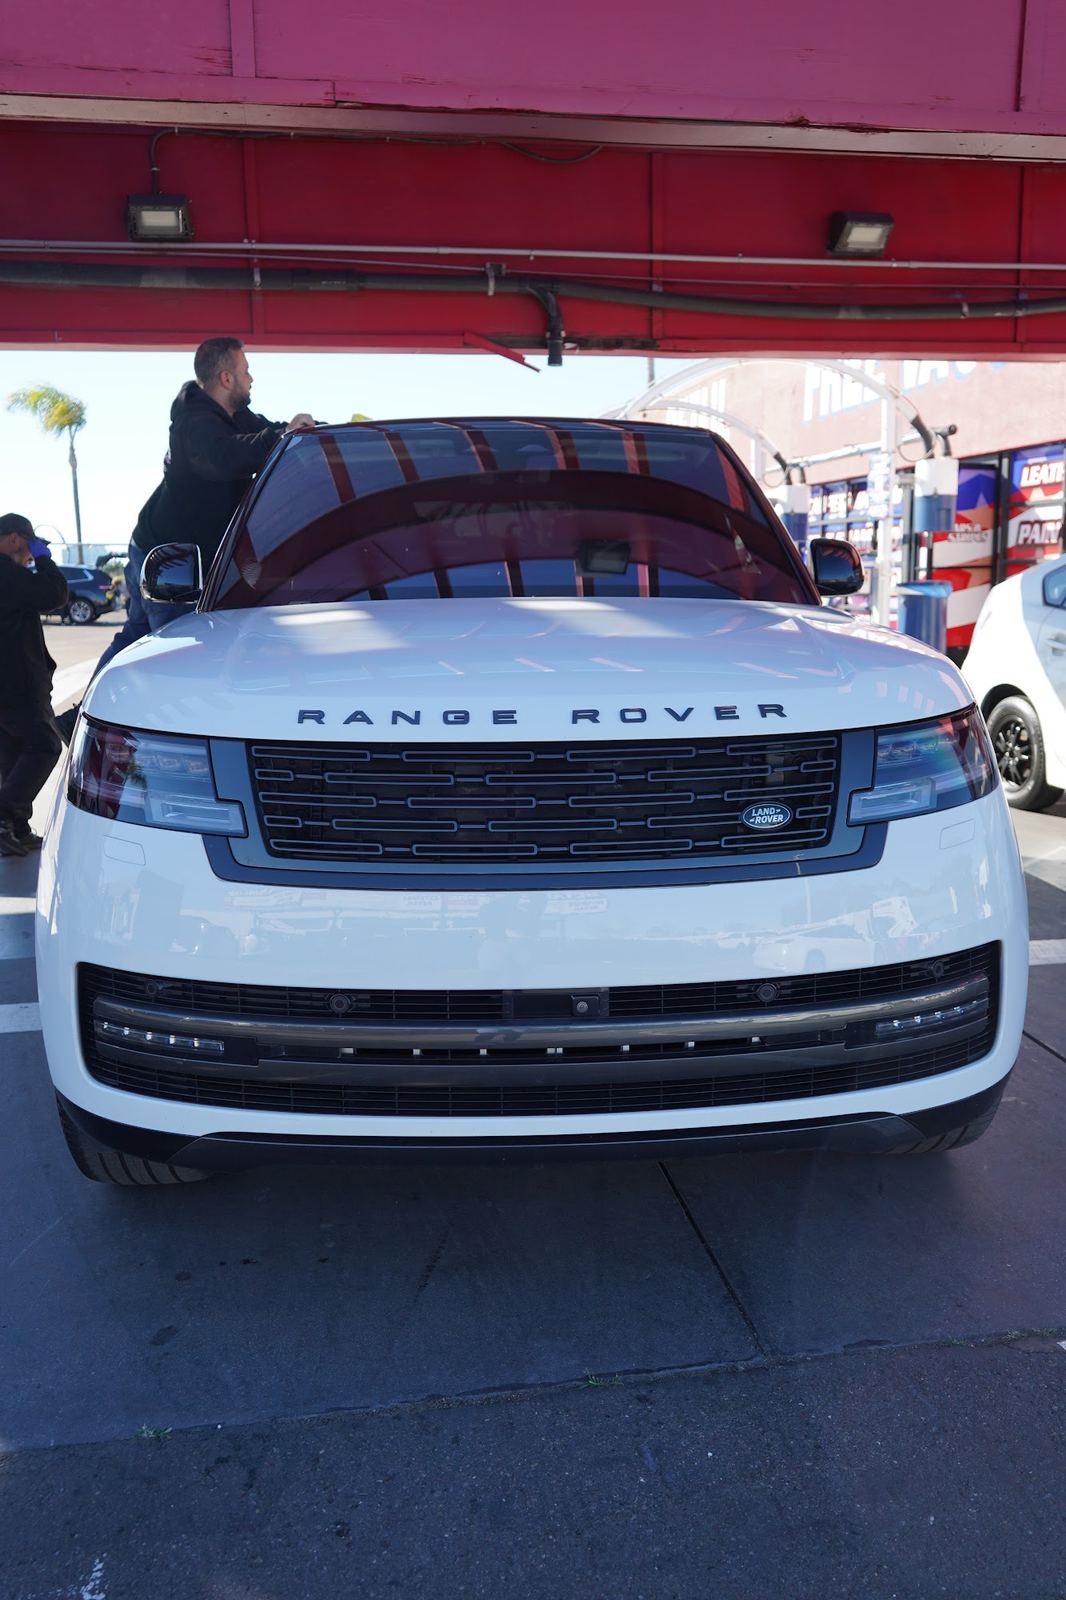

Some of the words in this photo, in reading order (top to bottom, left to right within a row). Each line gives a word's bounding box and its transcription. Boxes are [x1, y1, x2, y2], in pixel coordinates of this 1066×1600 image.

[297, 709, 518, 726] RANGE
[571, 703, 788, 725] ROVER
[752, 807, 776, 817] LAND
[755, 814, 784, 825] ROVER
